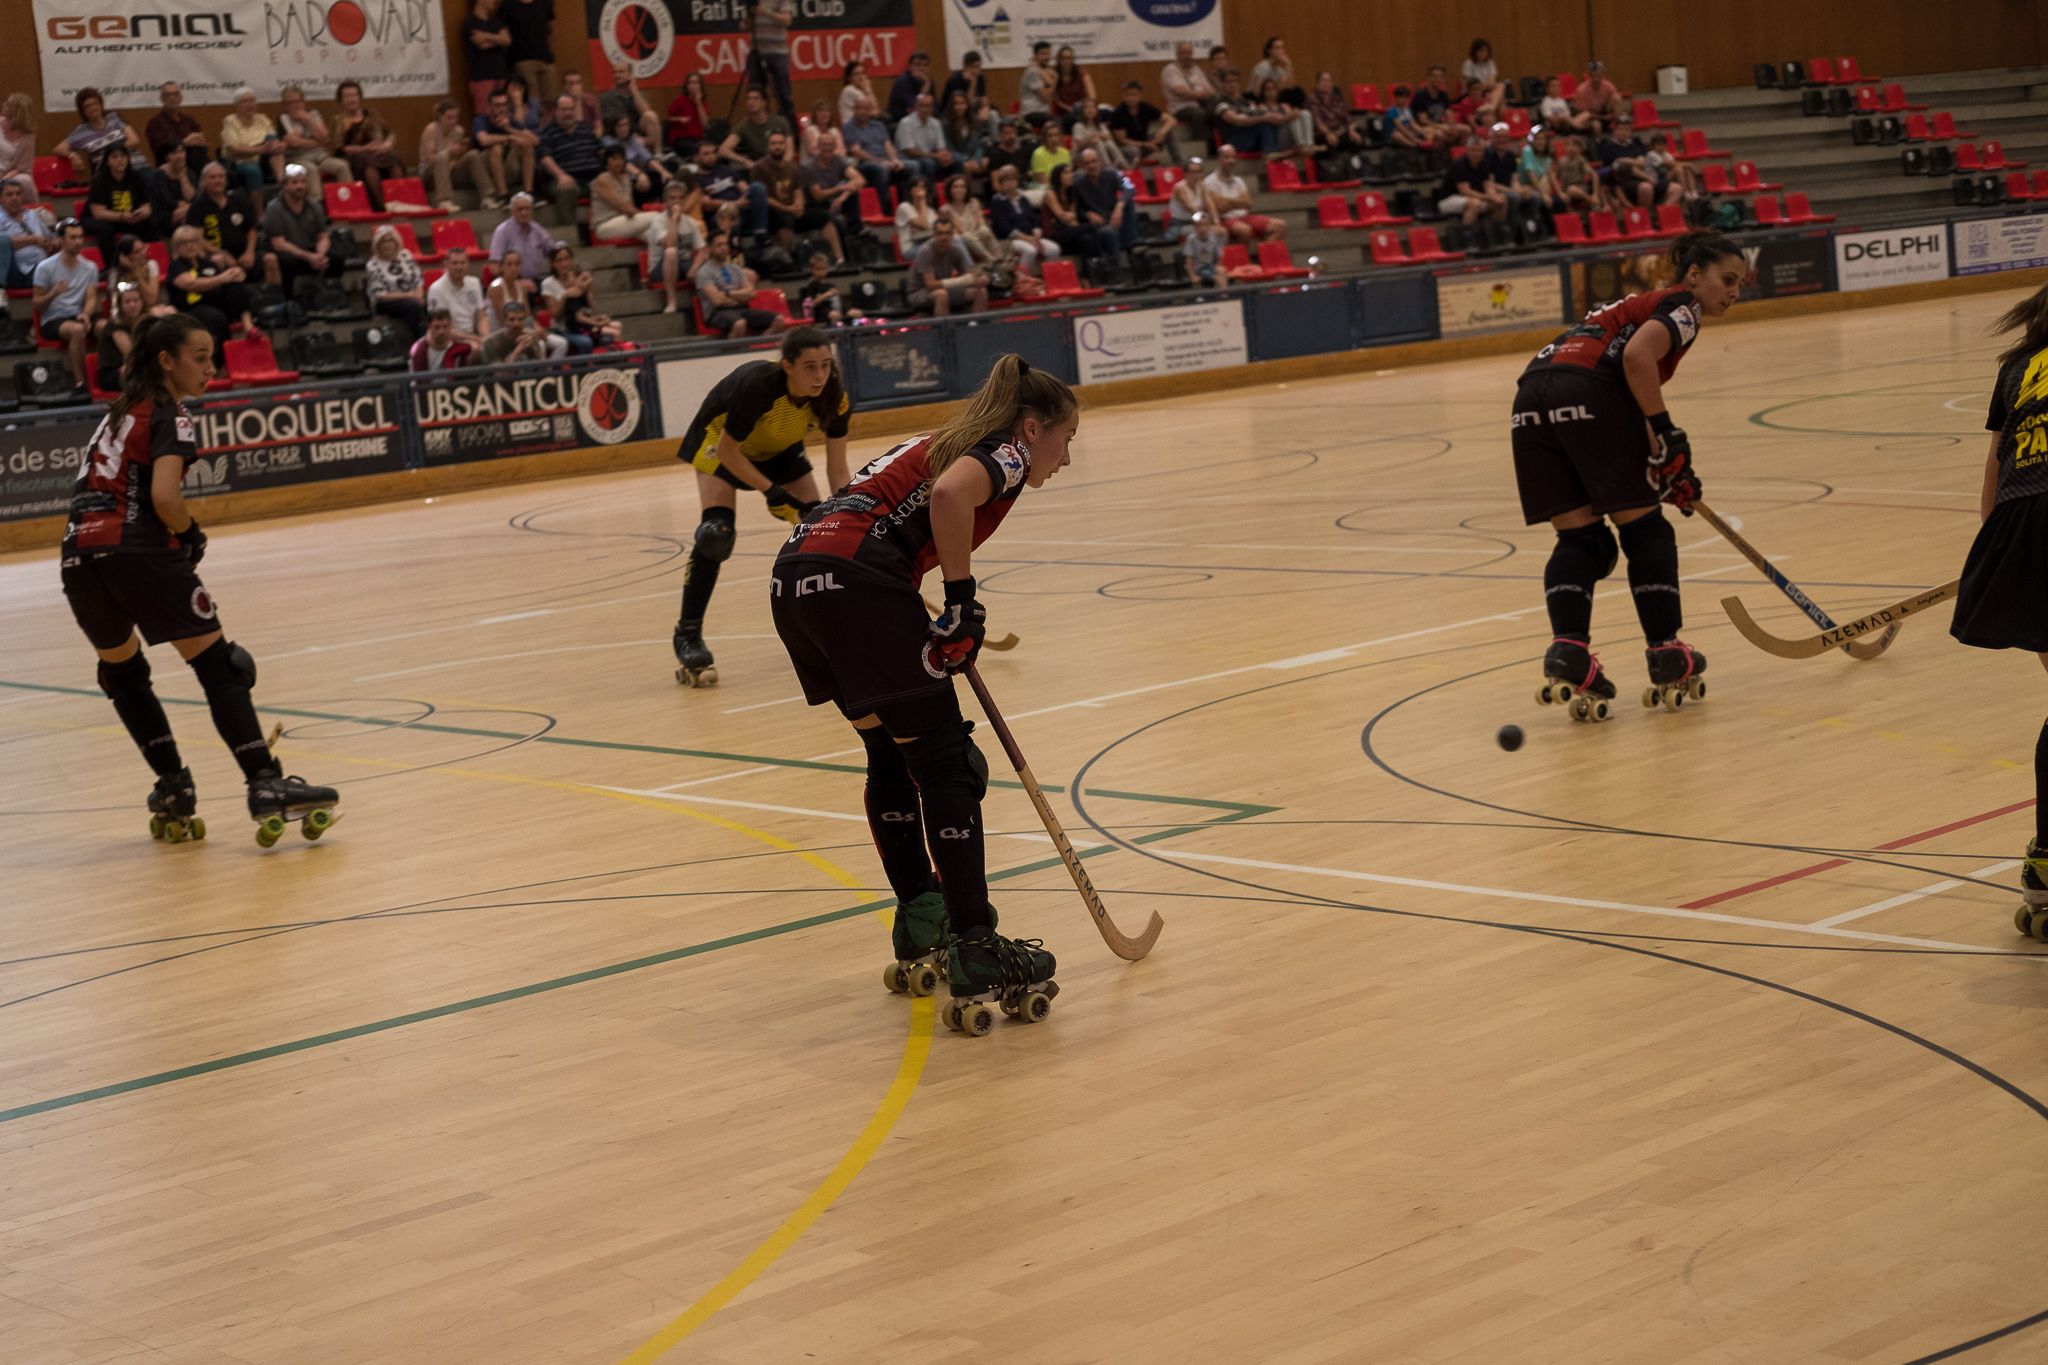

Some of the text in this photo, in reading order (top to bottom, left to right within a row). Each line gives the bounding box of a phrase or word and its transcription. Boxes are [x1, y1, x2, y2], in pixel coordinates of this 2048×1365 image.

[54, 40, 243, 55] AUTHENTIC HOCKEY
[696, 32, 898, 75] SAN CUGAT
[1844, 234, 1940, 262] DELPHI
[9, 445, 45, 474] de
